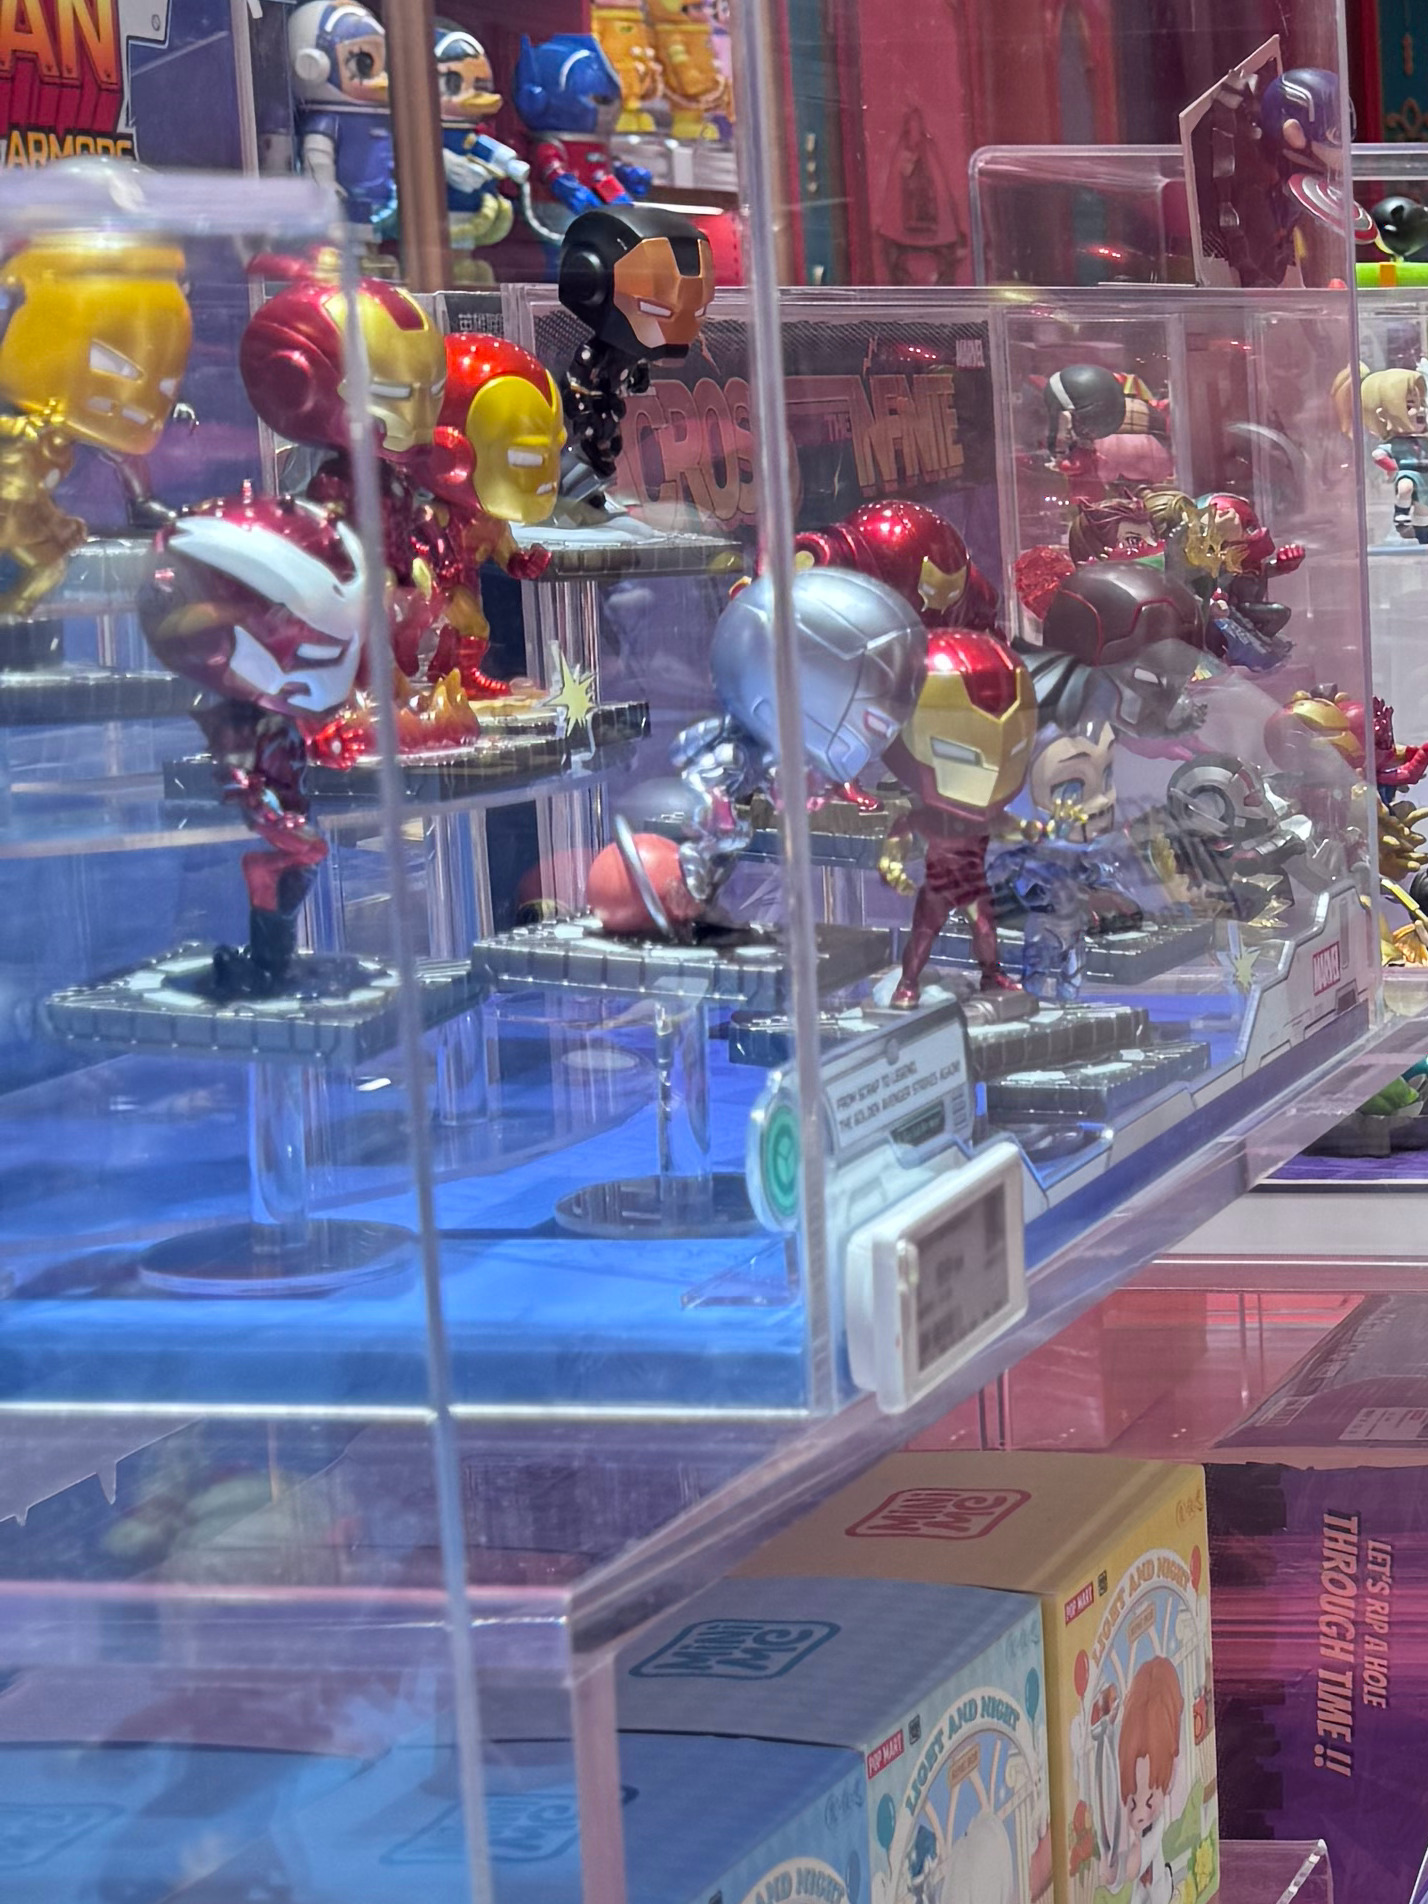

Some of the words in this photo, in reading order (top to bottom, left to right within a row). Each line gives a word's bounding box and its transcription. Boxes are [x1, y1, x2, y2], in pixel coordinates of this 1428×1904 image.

[1313, 943, 1340, 993] MARVEL
[1317, 1512, 1359, 1664] THROUGH
[1366, 1539, 1392, 1596] LET'S
[1364, 1597, 1390, 1635] RIP
[1364, 1635, 1388, 1653] A
[1317, 1667, 1353, 1744] TIME
[1362, 1655, 1388, 1709] HOLE
[949, 1698, 977, 1740] AND
[981, 1695, 1020, 1732] NIGHT
[869, 1748, 882, 1778] POP
[883, 1732, 903, 1765] MART
